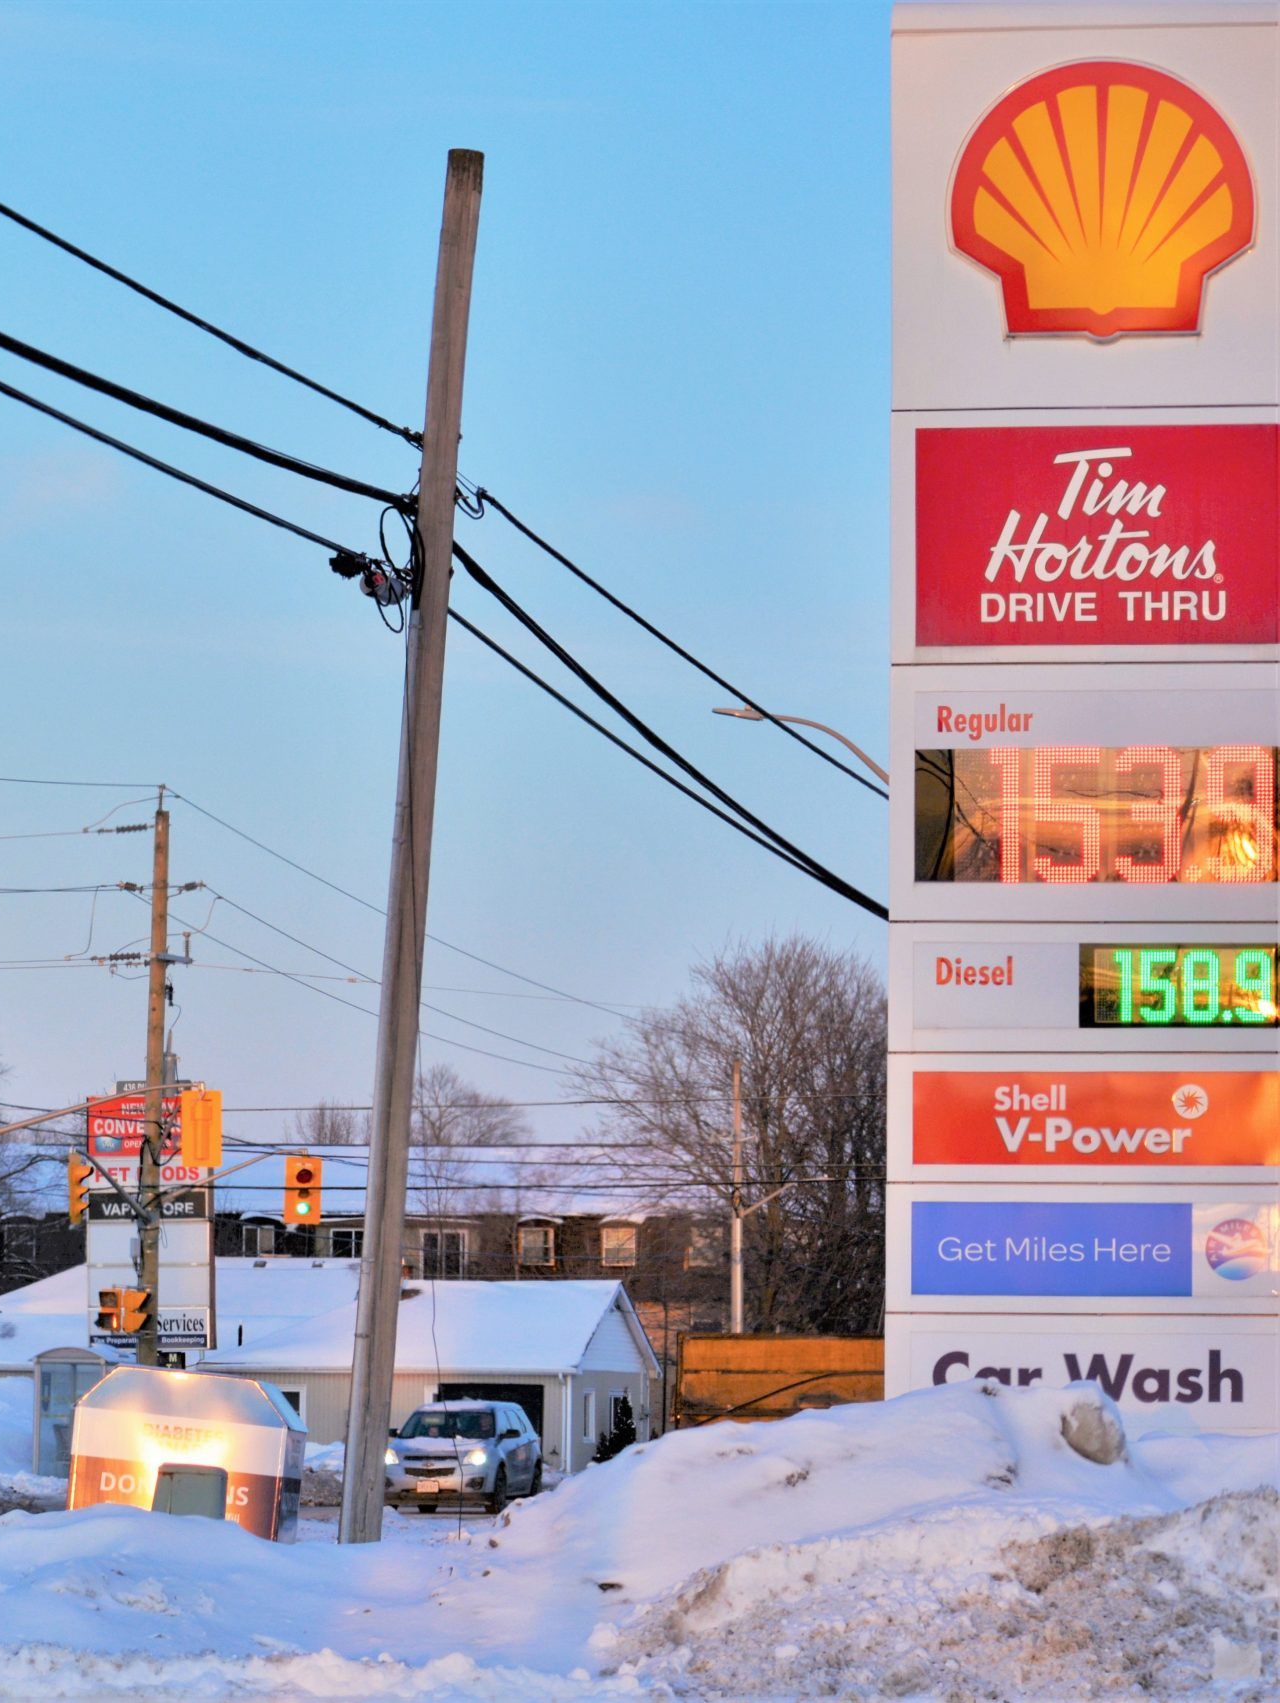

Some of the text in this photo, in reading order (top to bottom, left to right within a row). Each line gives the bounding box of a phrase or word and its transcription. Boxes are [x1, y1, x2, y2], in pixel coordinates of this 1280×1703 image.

[1053, 447, 1167, 520] Tim
[984, 509, 1217, 583] Hortons
[980, 590, 1226, 623] DRIVE THRU
[937, 704, 1033, 740] Regular
[989, 745, 1274, 883] 153.9
[936, 955, 1013, 985] Diesel
[1114, 949, 1272, 1024] 158.9
[994, 1085, 1066, 1111] Shell
[995, 1117, 1192, 1153] V-Power
[938, 1237, 1171, 1262] Get Miles Here
[162, 1336, 204, 1344] Bookkeeping
[1064, 1349, 1244, 1403] Wash
